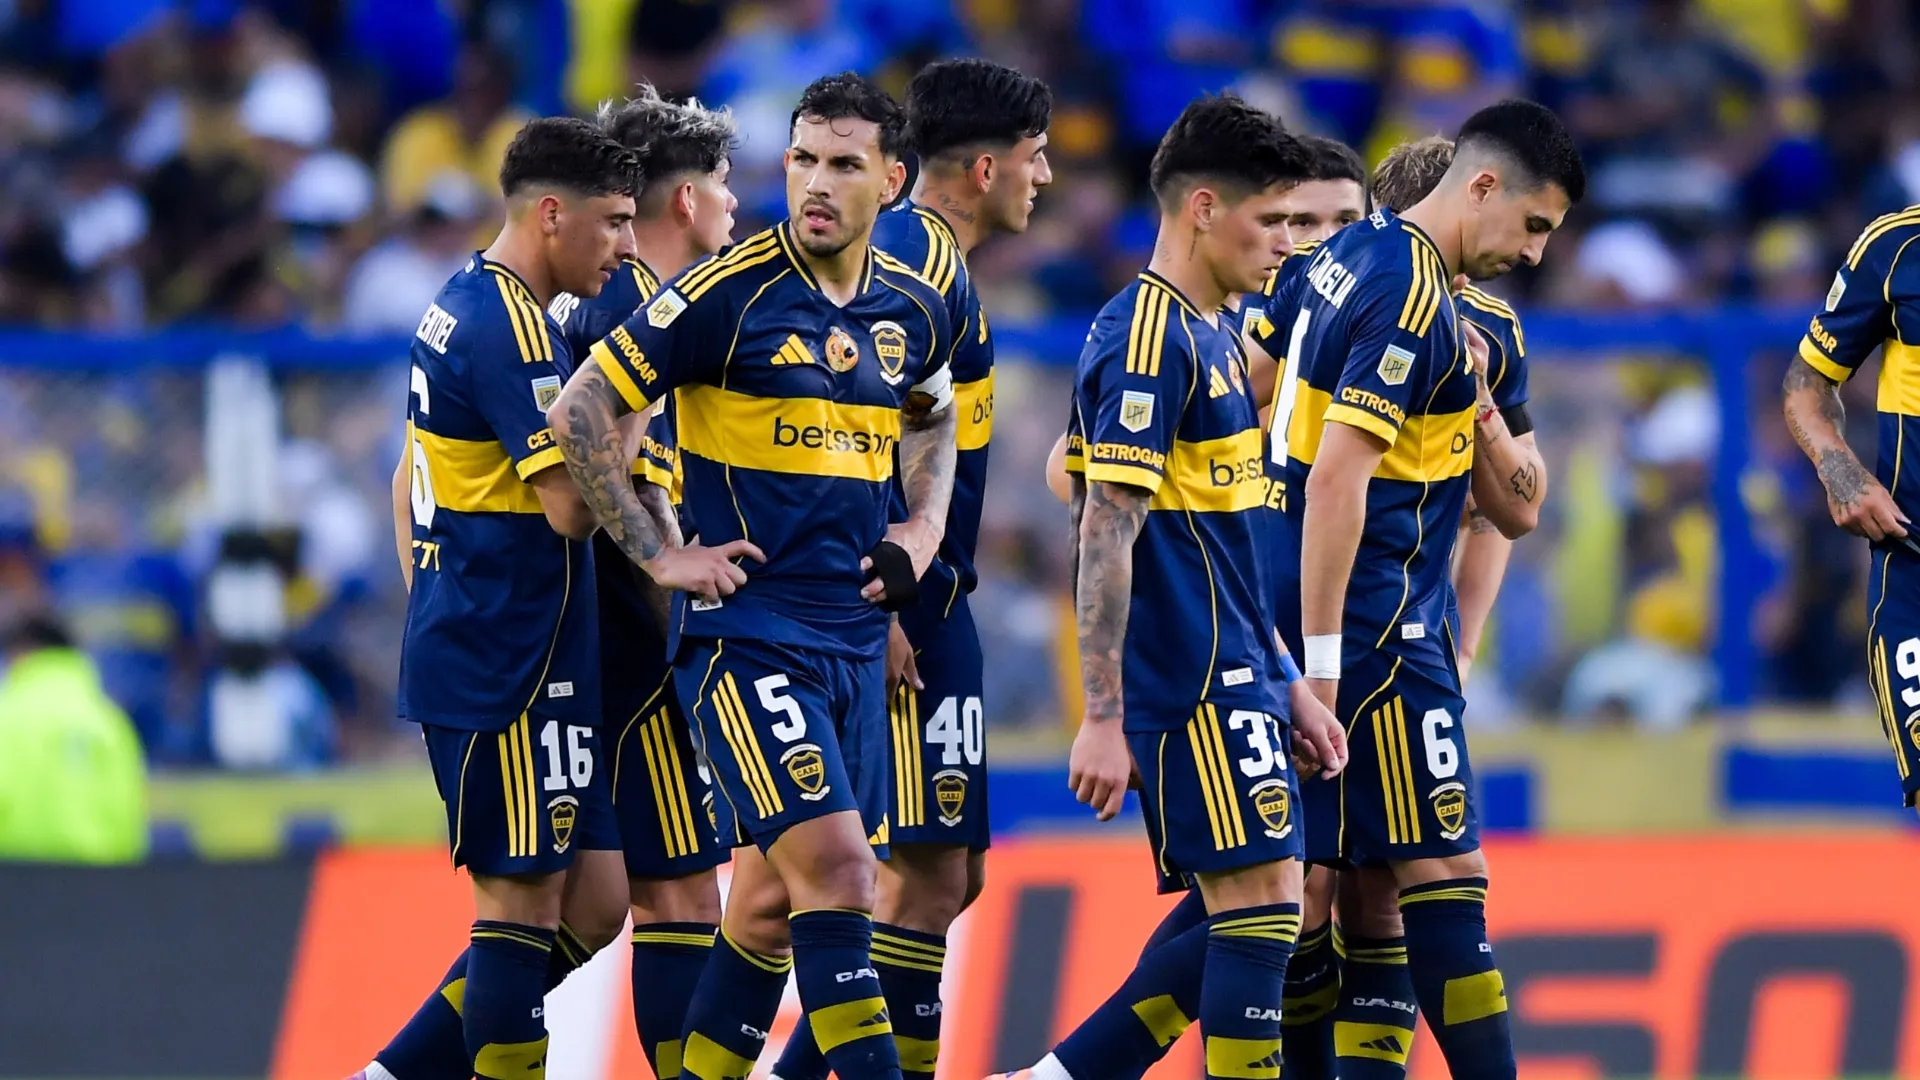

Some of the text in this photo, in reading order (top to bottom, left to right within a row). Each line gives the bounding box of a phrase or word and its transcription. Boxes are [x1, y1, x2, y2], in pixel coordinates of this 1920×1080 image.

[1094, 443, 1165, 470] CETROGAR
[753, 673, 807, 743] 5
[926, 696, 982, 765] 40
[1421, 708, 1459, 779] 6
[540, 720, 593, 791] 16
[796, 764, 818, 778] CABJ
[940, 791, 960, 801] CABJ
[1262, 803, 1283, 814] CABJ
[1440, 803, 1459, 815] CABJ
